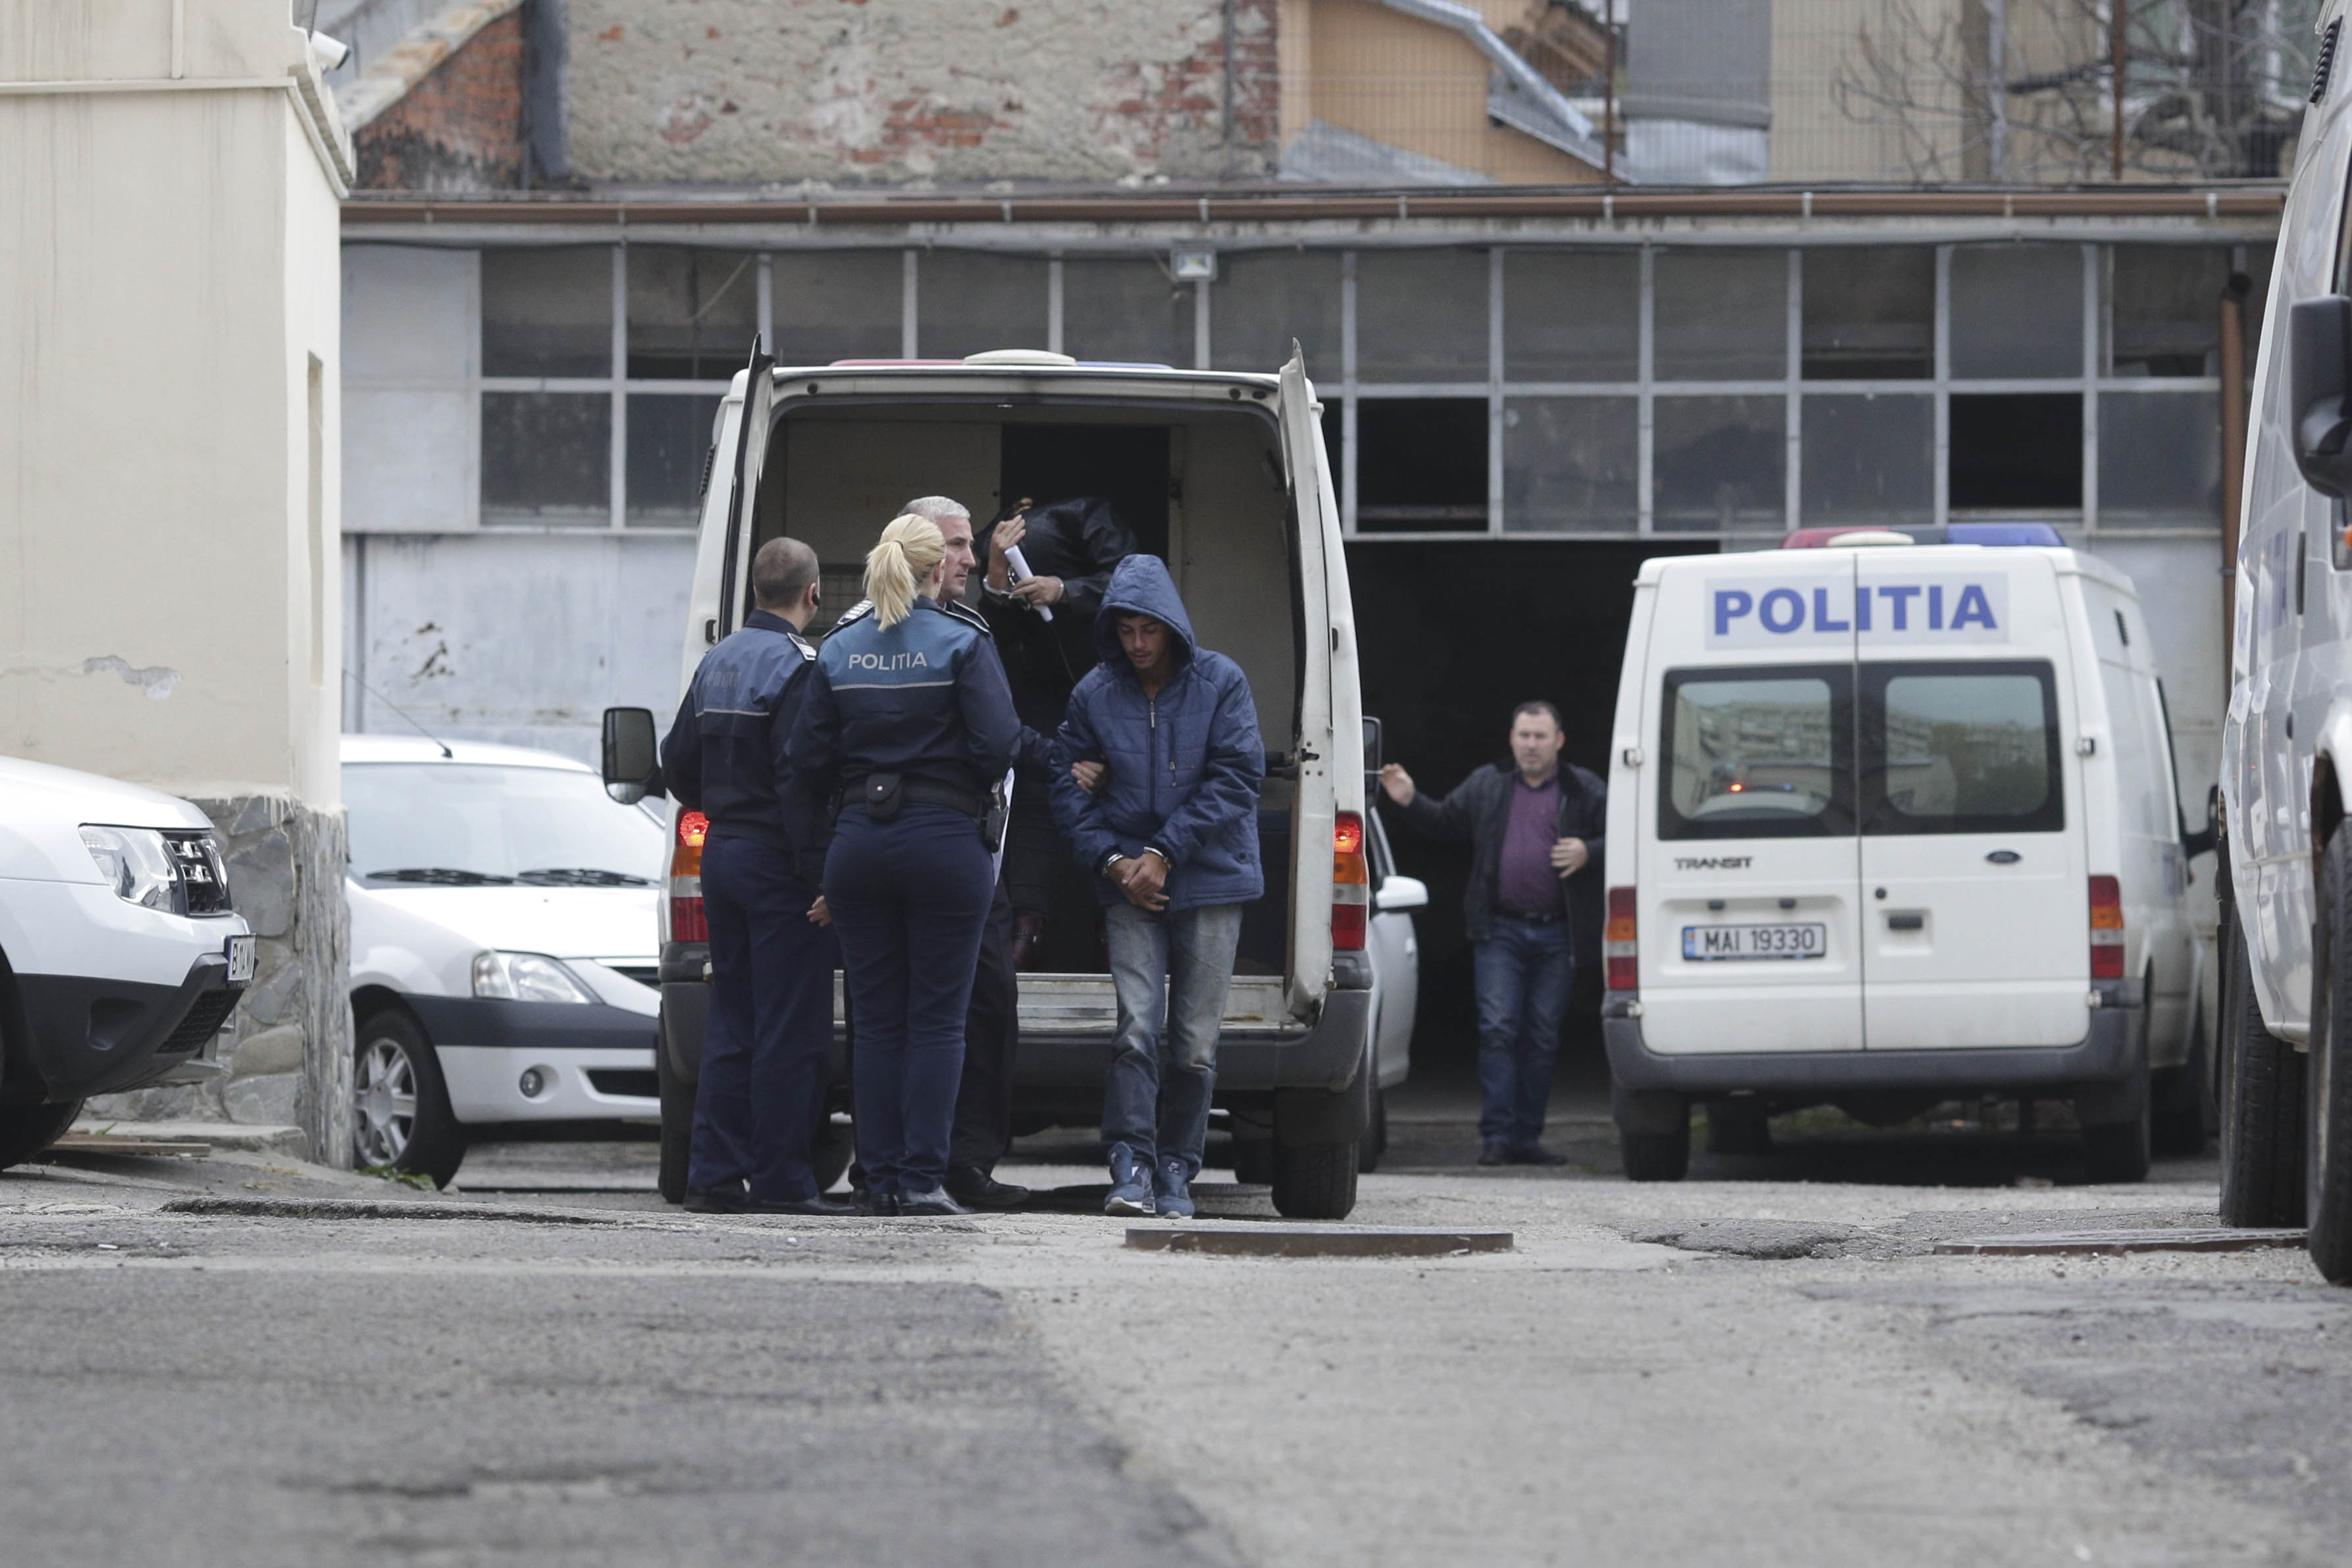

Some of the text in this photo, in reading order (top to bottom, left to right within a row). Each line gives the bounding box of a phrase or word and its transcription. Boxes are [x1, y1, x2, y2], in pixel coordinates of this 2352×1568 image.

[1713, 585, 1998, 636] POLITIA
[848, 652, 928, 671] POLITIA
[1674, 856, 1754, 870] TRANSIT
[1704, 928, 1815, 953] MAI 19330
